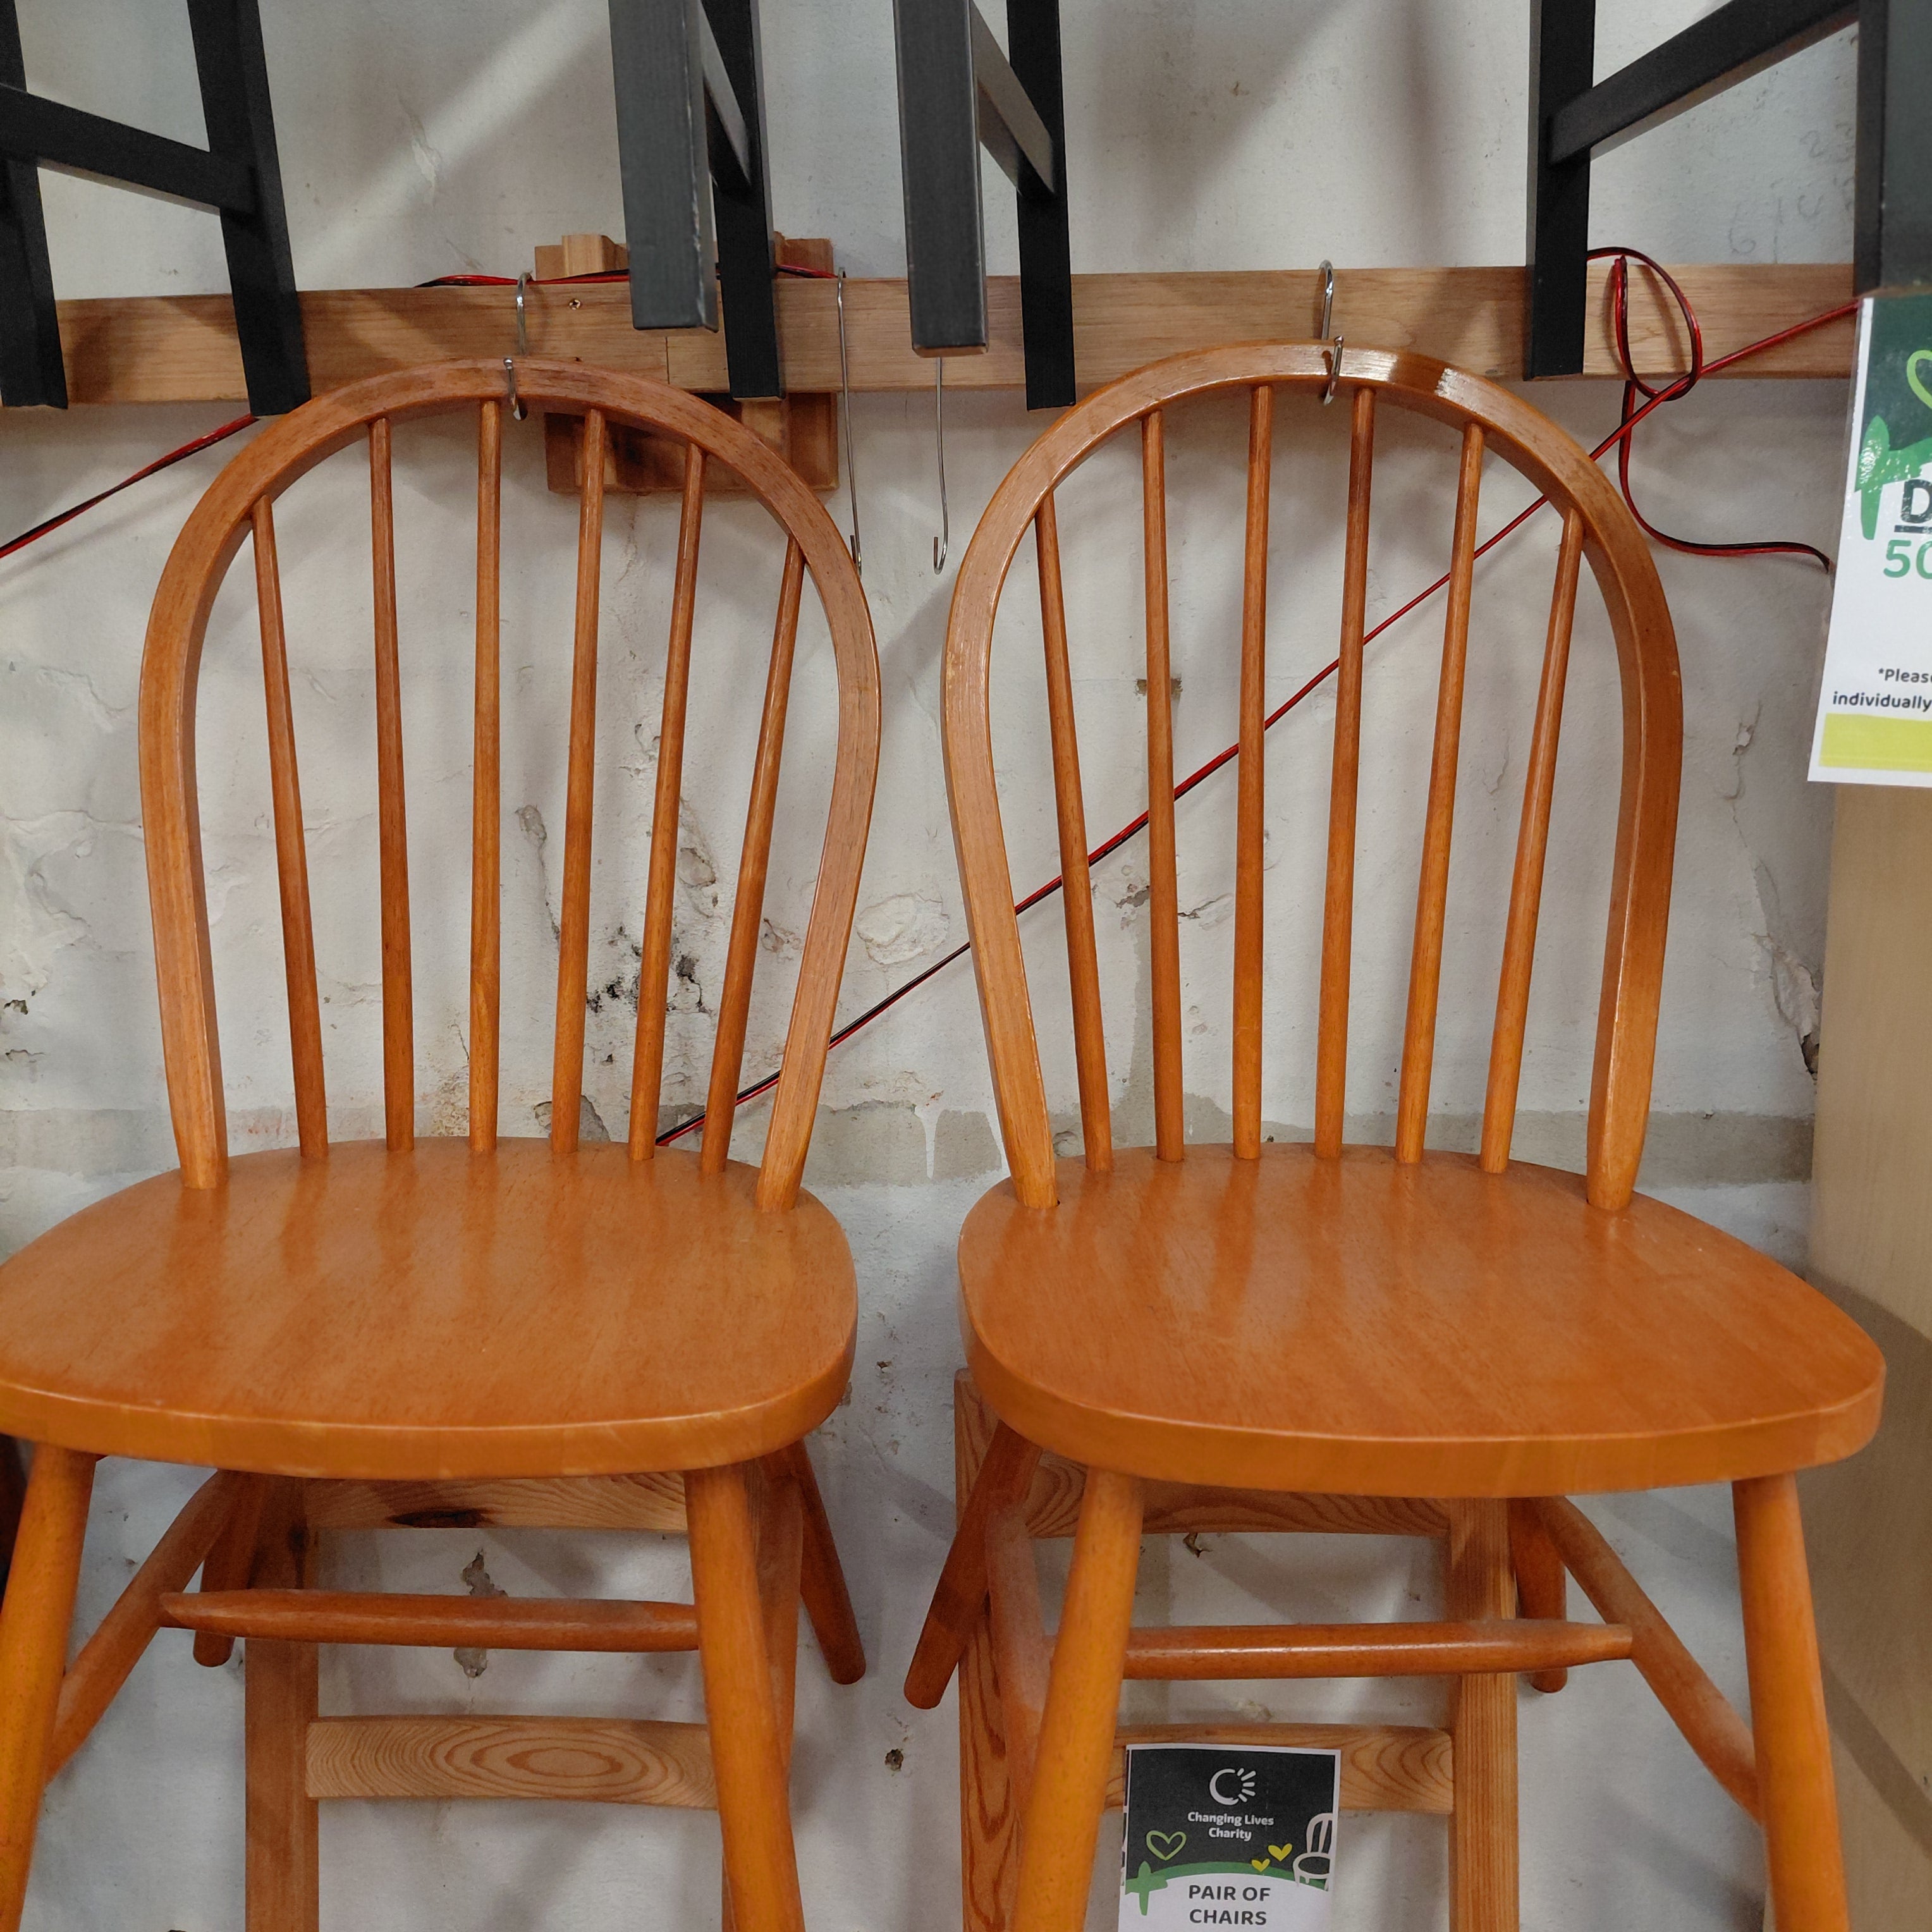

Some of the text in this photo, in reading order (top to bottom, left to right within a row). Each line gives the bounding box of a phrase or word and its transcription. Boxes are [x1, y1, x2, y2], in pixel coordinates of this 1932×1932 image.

[1878, 668, 1932, 683] Pleas
[1833, 691, 1932, 712] individually
[1187, 1811, 1275, 1826] Changing Lives
[1208, 1828, 1252, 1841] Charity
[1189, 1885, 1271, 1902] PAIR OF
[1189, 1909, 1267, 1926] CHAIRS
